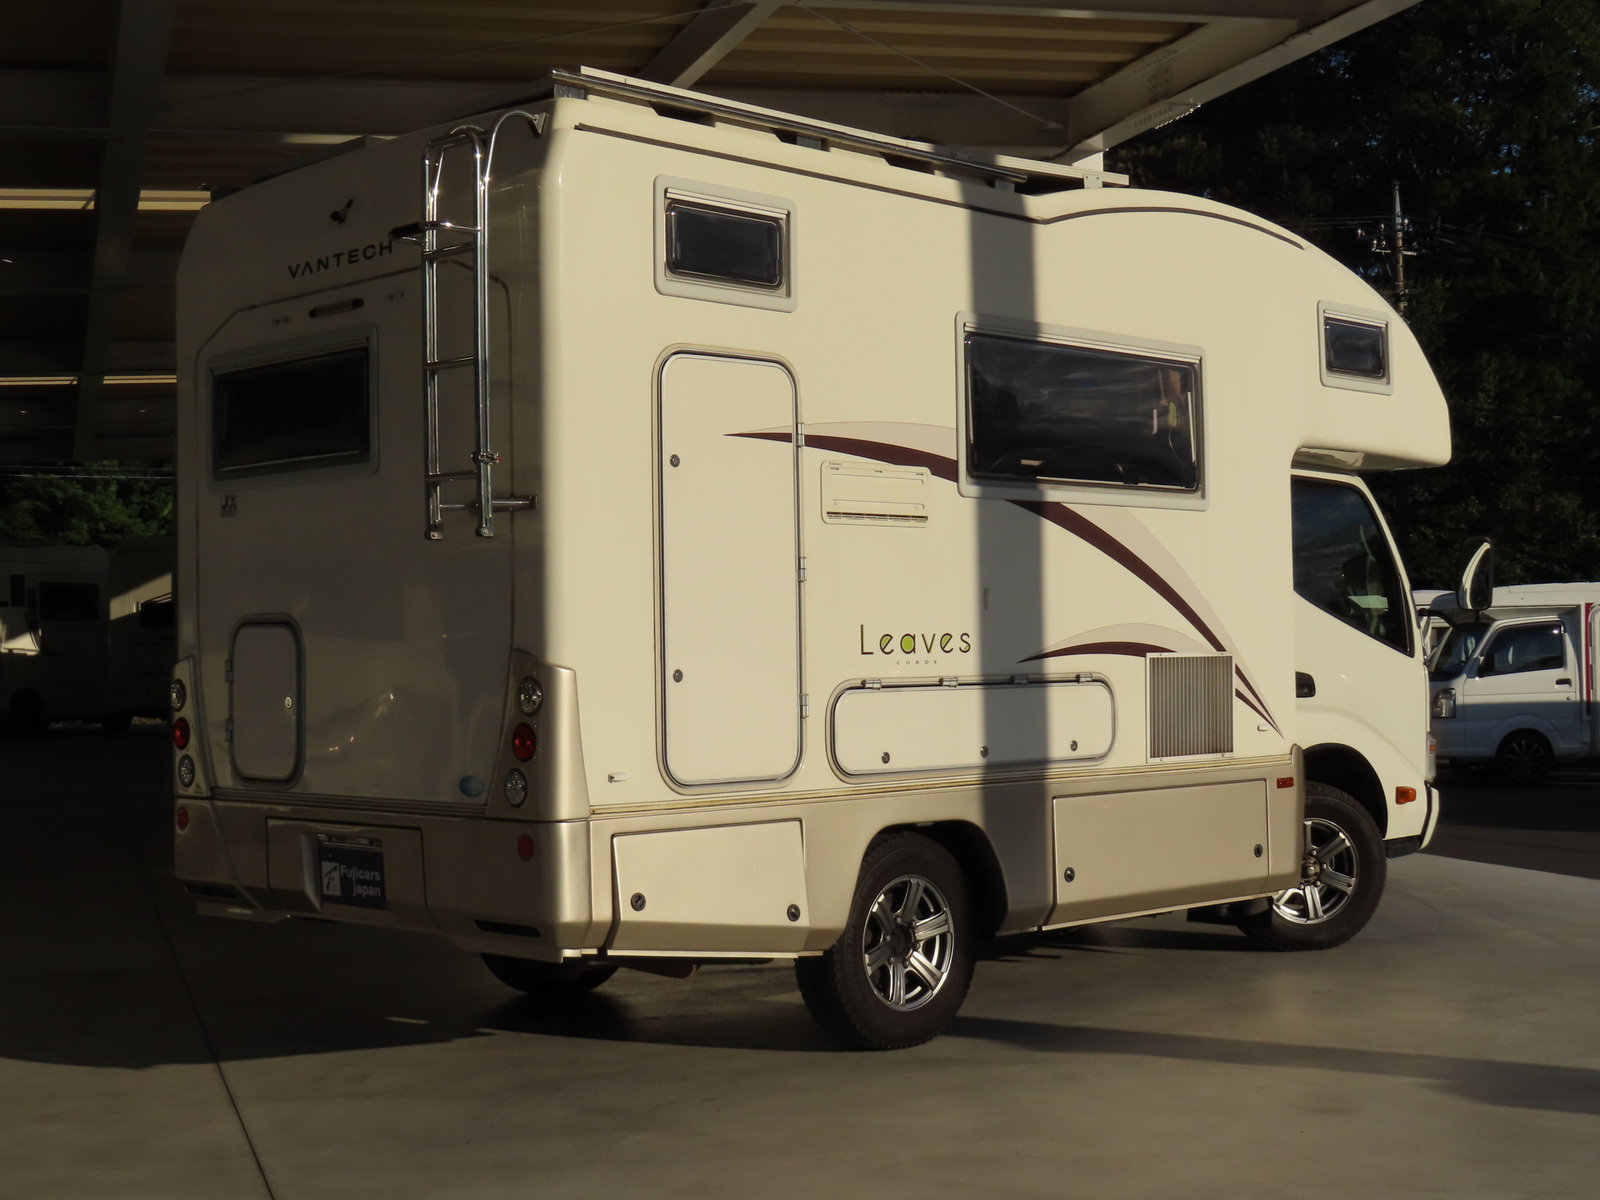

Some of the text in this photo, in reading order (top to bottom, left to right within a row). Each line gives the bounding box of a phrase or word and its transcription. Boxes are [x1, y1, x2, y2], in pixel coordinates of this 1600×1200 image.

[287, 240, 393, 279] VANTECH
[860, 623, 972, 655] Leaves
[340, 864, 381, 882] Fujicars
